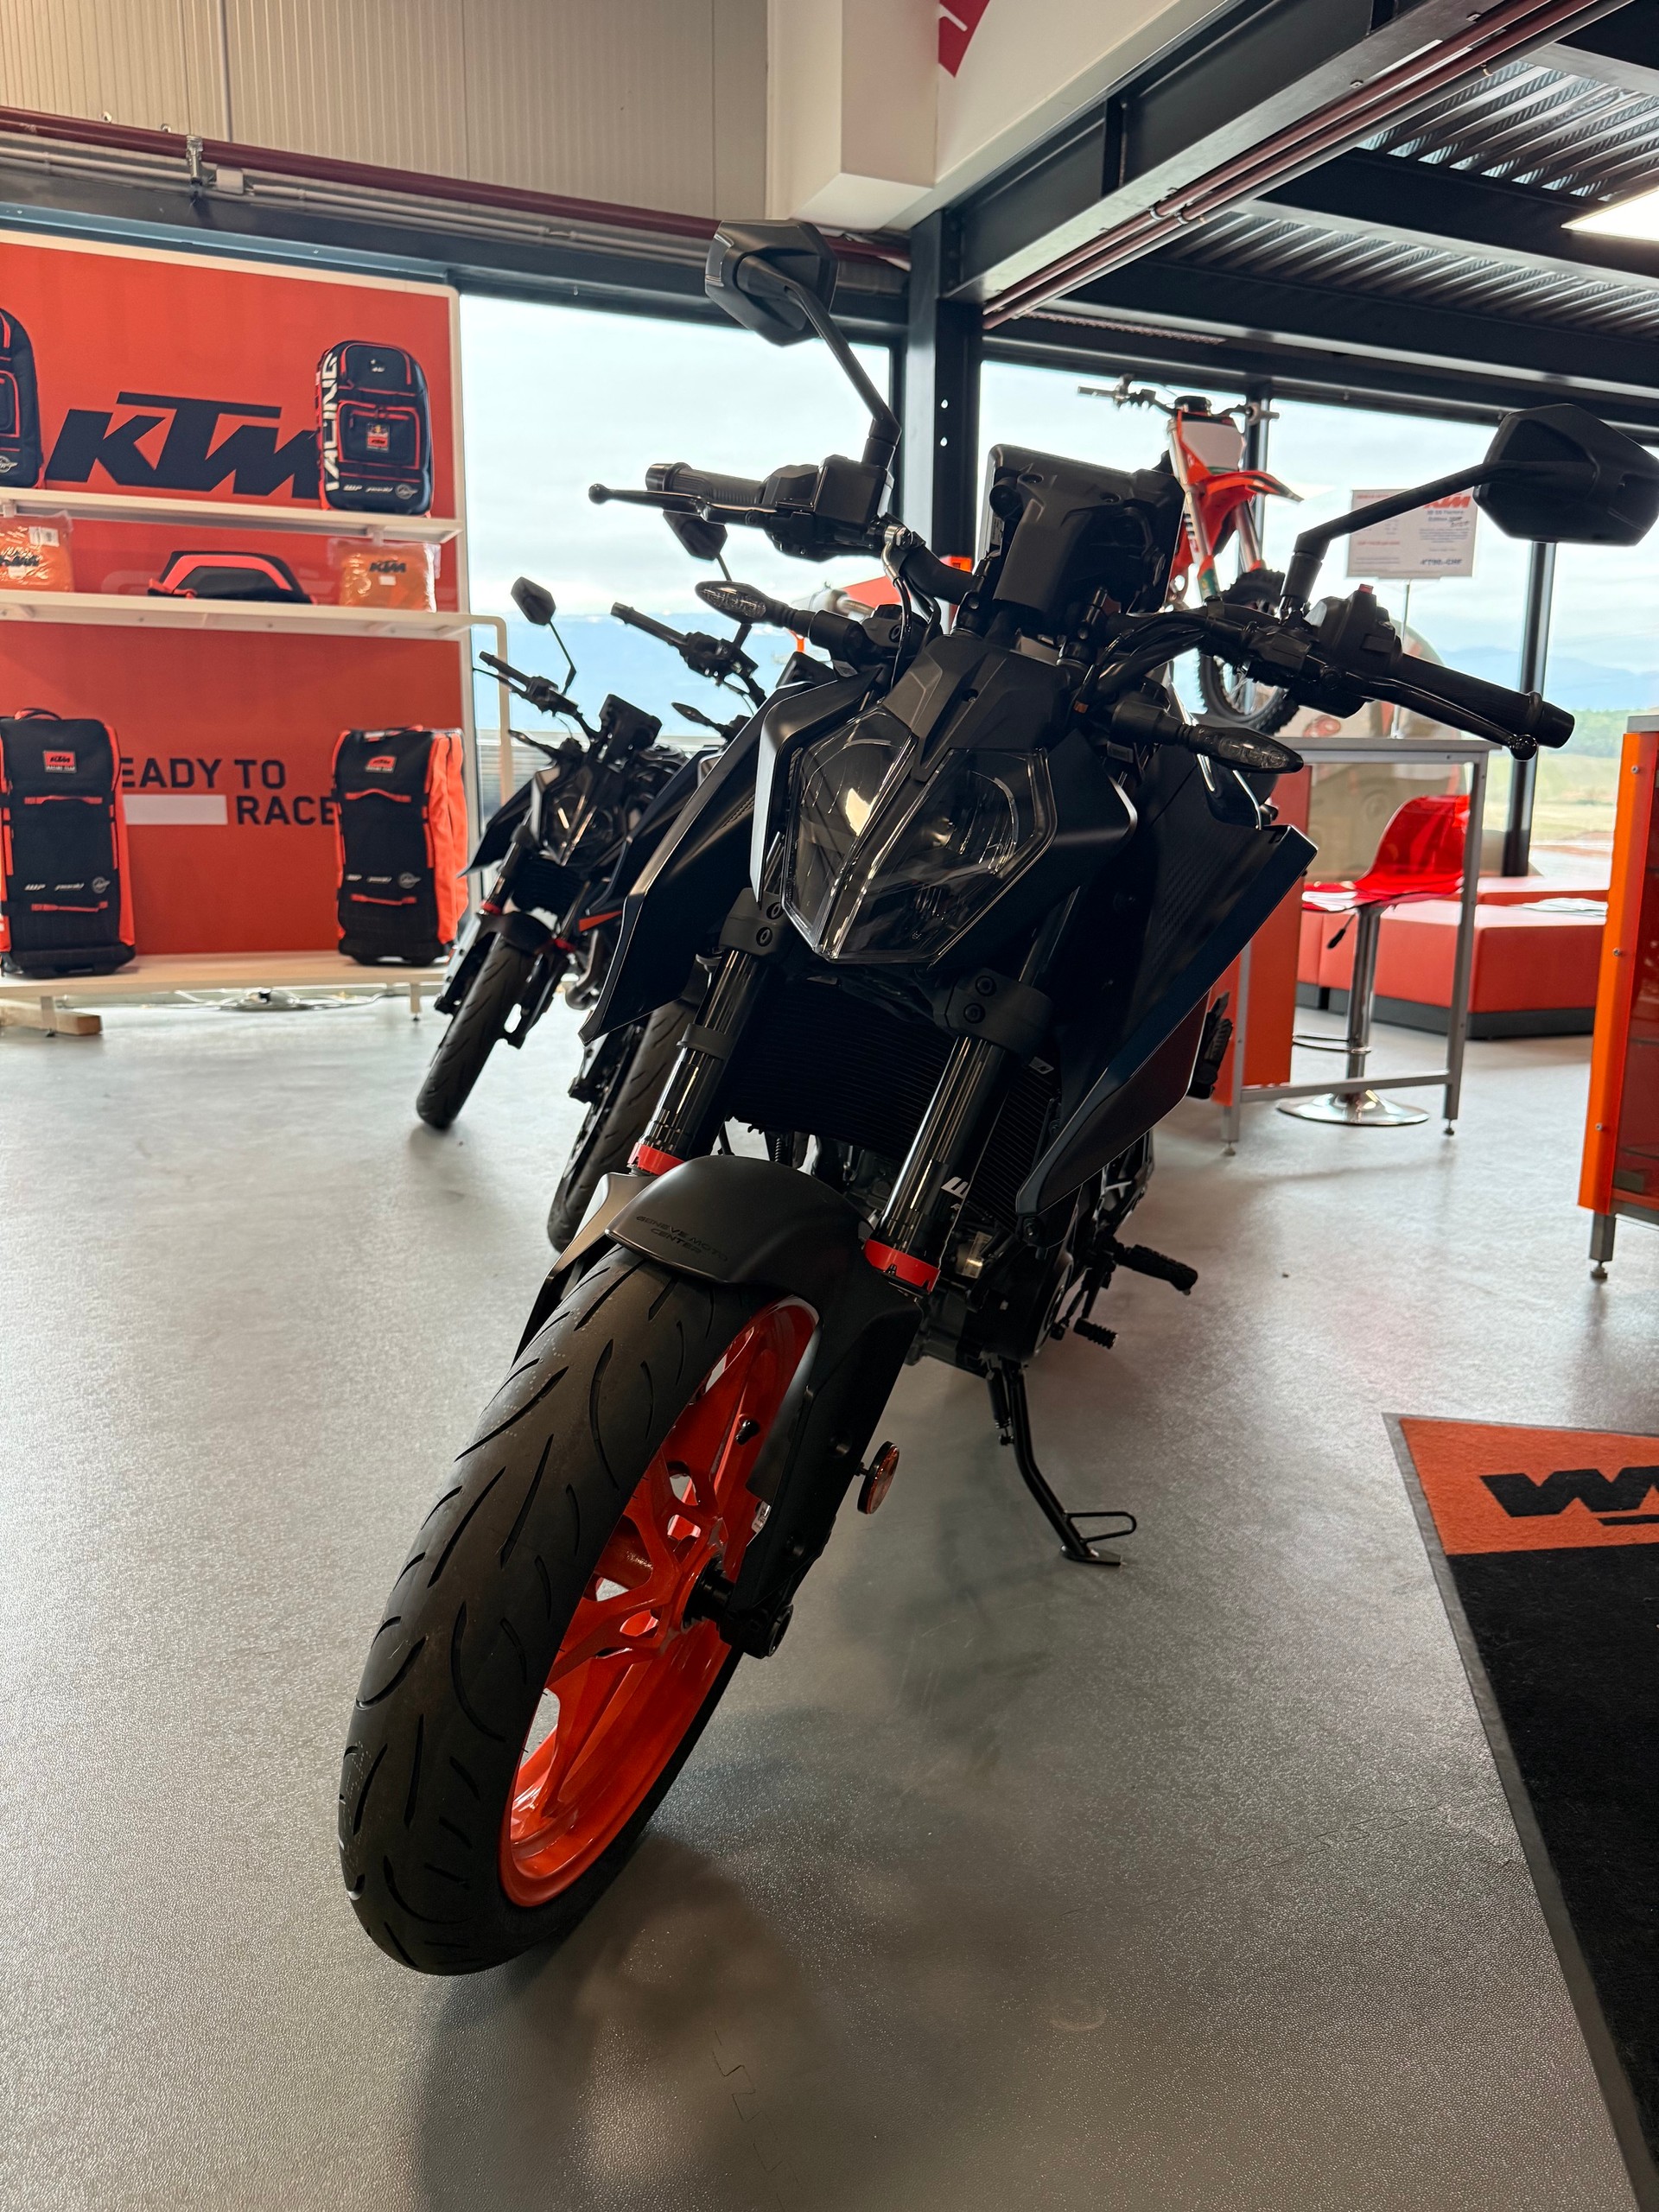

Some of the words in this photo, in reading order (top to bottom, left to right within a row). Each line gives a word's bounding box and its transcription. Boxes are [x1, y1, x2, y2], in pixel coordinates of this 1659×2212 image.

[45, 391, 323, 499] KTM
[368, 560, 406, 573] KTM
[119, 757, 223, 789] EADY
[233, 759, 287, 790] TO
[650, 1228, 702, 1254] CENTER
